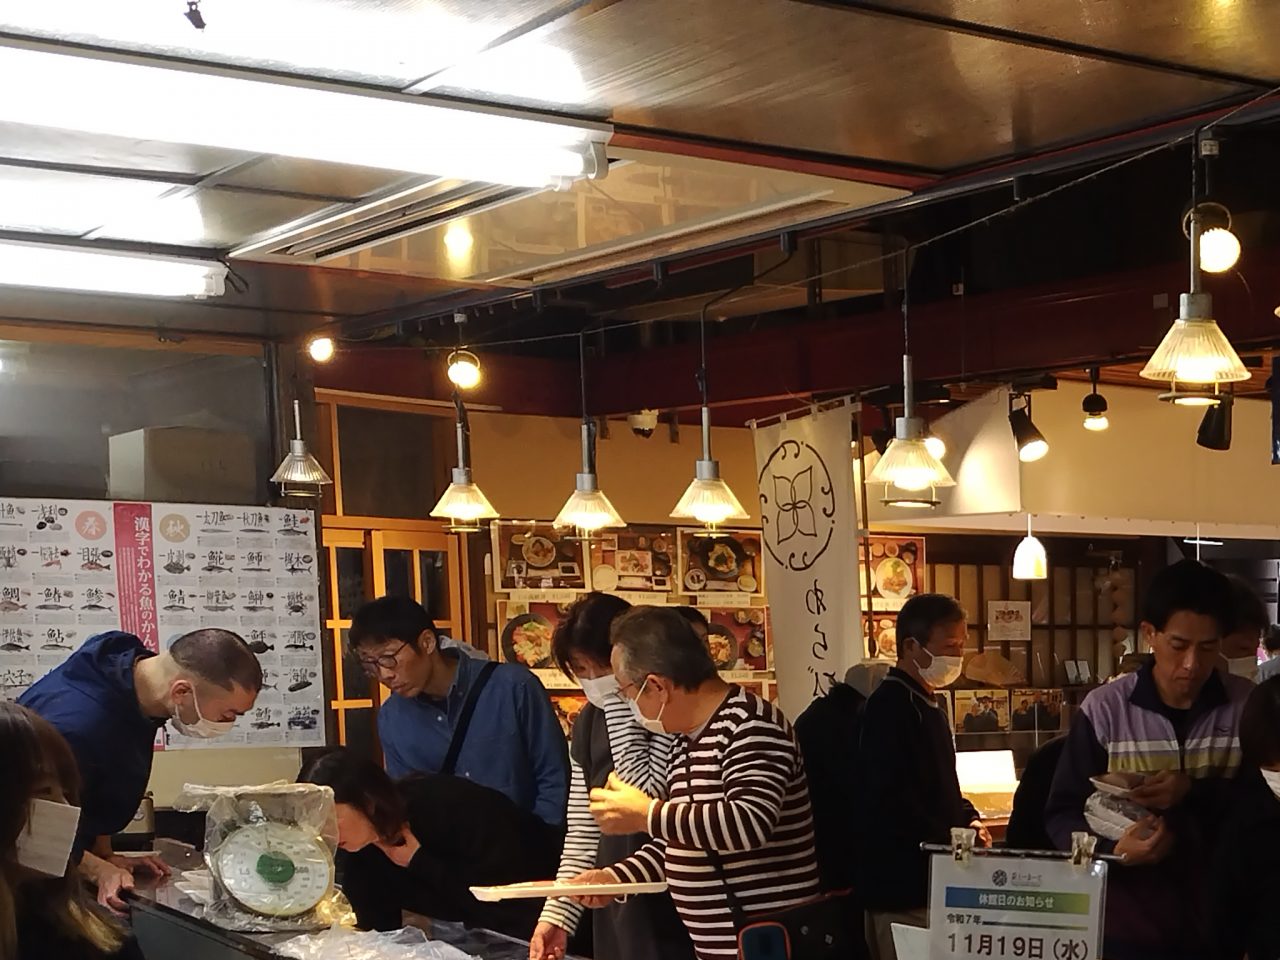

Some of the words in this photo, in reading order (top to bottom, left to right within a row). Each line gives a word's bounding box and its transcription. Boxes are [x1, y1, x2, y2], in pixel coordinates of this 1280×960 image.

[165, 518, 186, 538] 秋
[134, 516, 156, 651] 漢字でわかる魚のかん
[979, 893, 1055, 909] 休館日のお知らせ
[946, 912, 983, 926] 令和7年
